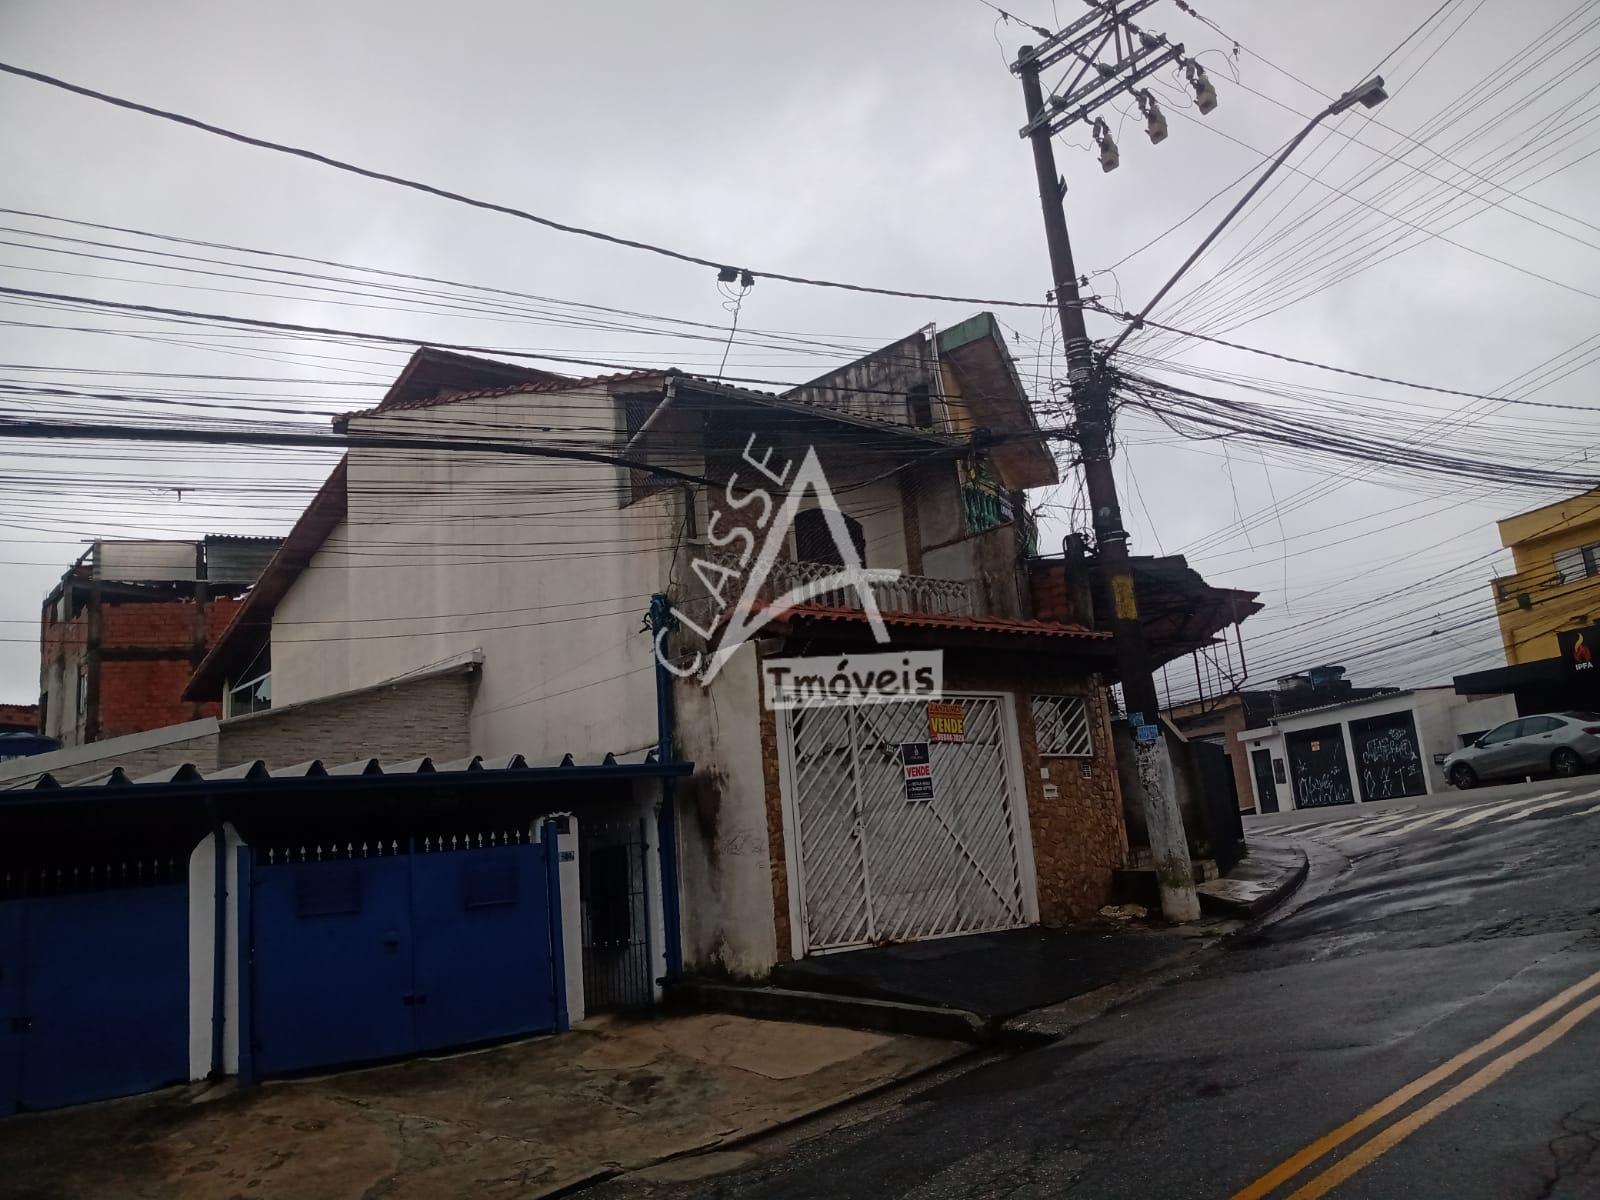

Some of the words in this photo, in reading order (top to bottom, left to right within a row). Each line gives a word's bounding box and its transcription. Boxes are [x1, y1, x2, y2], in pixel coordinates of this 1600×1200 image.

[1575, 661, 1594, 671] IPFA
[931, 718, 963, 733] VENDE
[906, 765, 931, 778] VENDE
